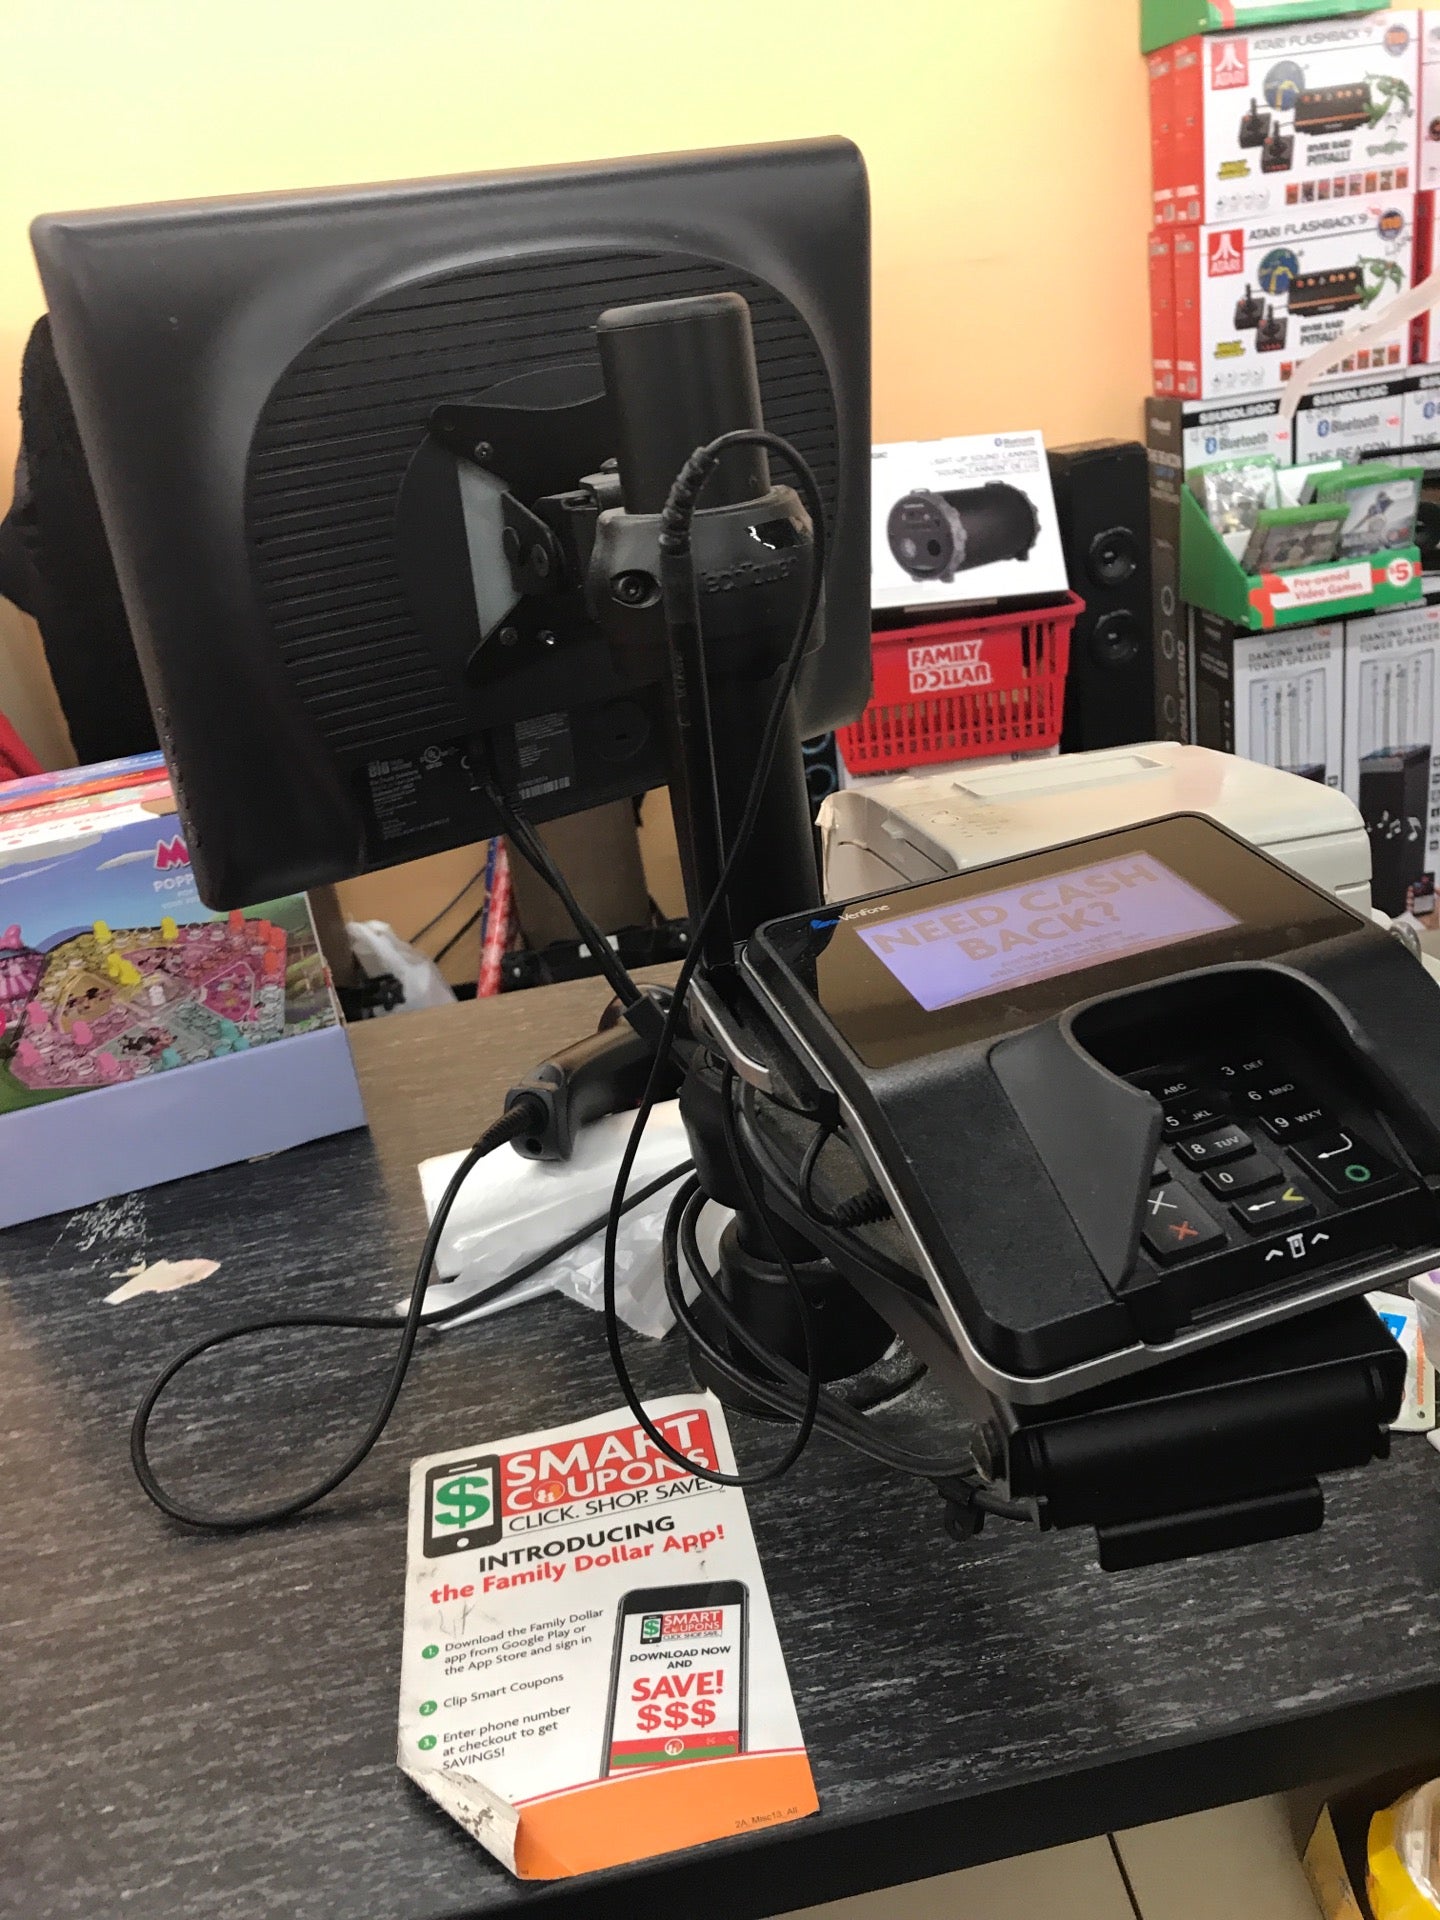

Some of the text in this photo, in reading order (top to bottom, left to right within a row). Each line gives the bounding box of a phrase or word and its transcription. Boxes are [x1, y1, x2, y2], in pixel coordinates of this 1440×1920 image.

[1250, 226, 1281, 240] ATARI
[1284, 215, 1356, 237] FLASHBACK
[1211, 259, 1241, 273] ATARI
[1293, 569, 1350, 588] Pre-owned
[1295, 582, 1363, 600] Video Games
[909, 641, 980, 669] FAMILY
[912, 663, 989, 691] DOLLAR
[871, 863, 1160, 954] NEED CASH
[957, 902, 1123, 961] BACK?
[1220, 1058, 1265, 1077] 3 DEF
[1163, 1083, 1187, 1096] ABC
[1247, 1083, 1295, 1102] 6 MNO
[1165, 1109, 1214, 1127] 5 JKL
[1274, 1108, 1323, 1129] 9 WXY
[1190, 1135, 1240, 1155] 8 TUV
[506, 1412, 701, 1487] SMART
[508, 1477, 713, 1532] CLICK. SHOP. SAVE.
[479, 1515, 676, 1573] INTRODUCING
[430, 1524, 726, 1605] the Family Dollar App!
[444, 1608, 604, 1652] Download the Family Dollar
[664, 1610, 721, 1626] SMART
[444, 1625, 587, 1666] app from Google Play or
[444, 1634, 592, 1677] the App Store and sign in
[629, 1645, 732, 1662] DOWNLOAD NOW
[666, 1659, 693, 1670] AND
[443, 1672, 564, 1709] Clip Smart Coupons
[631, 1669, 724, 1703] SAVE!
[443, 1704, 572, 1744] Enter phone number
[636, 1699, 716, 1733] $$$
[442, 1721, 559, 1758] at checkout to get
[442, 1747, 505, 1771] SAVINGS!
